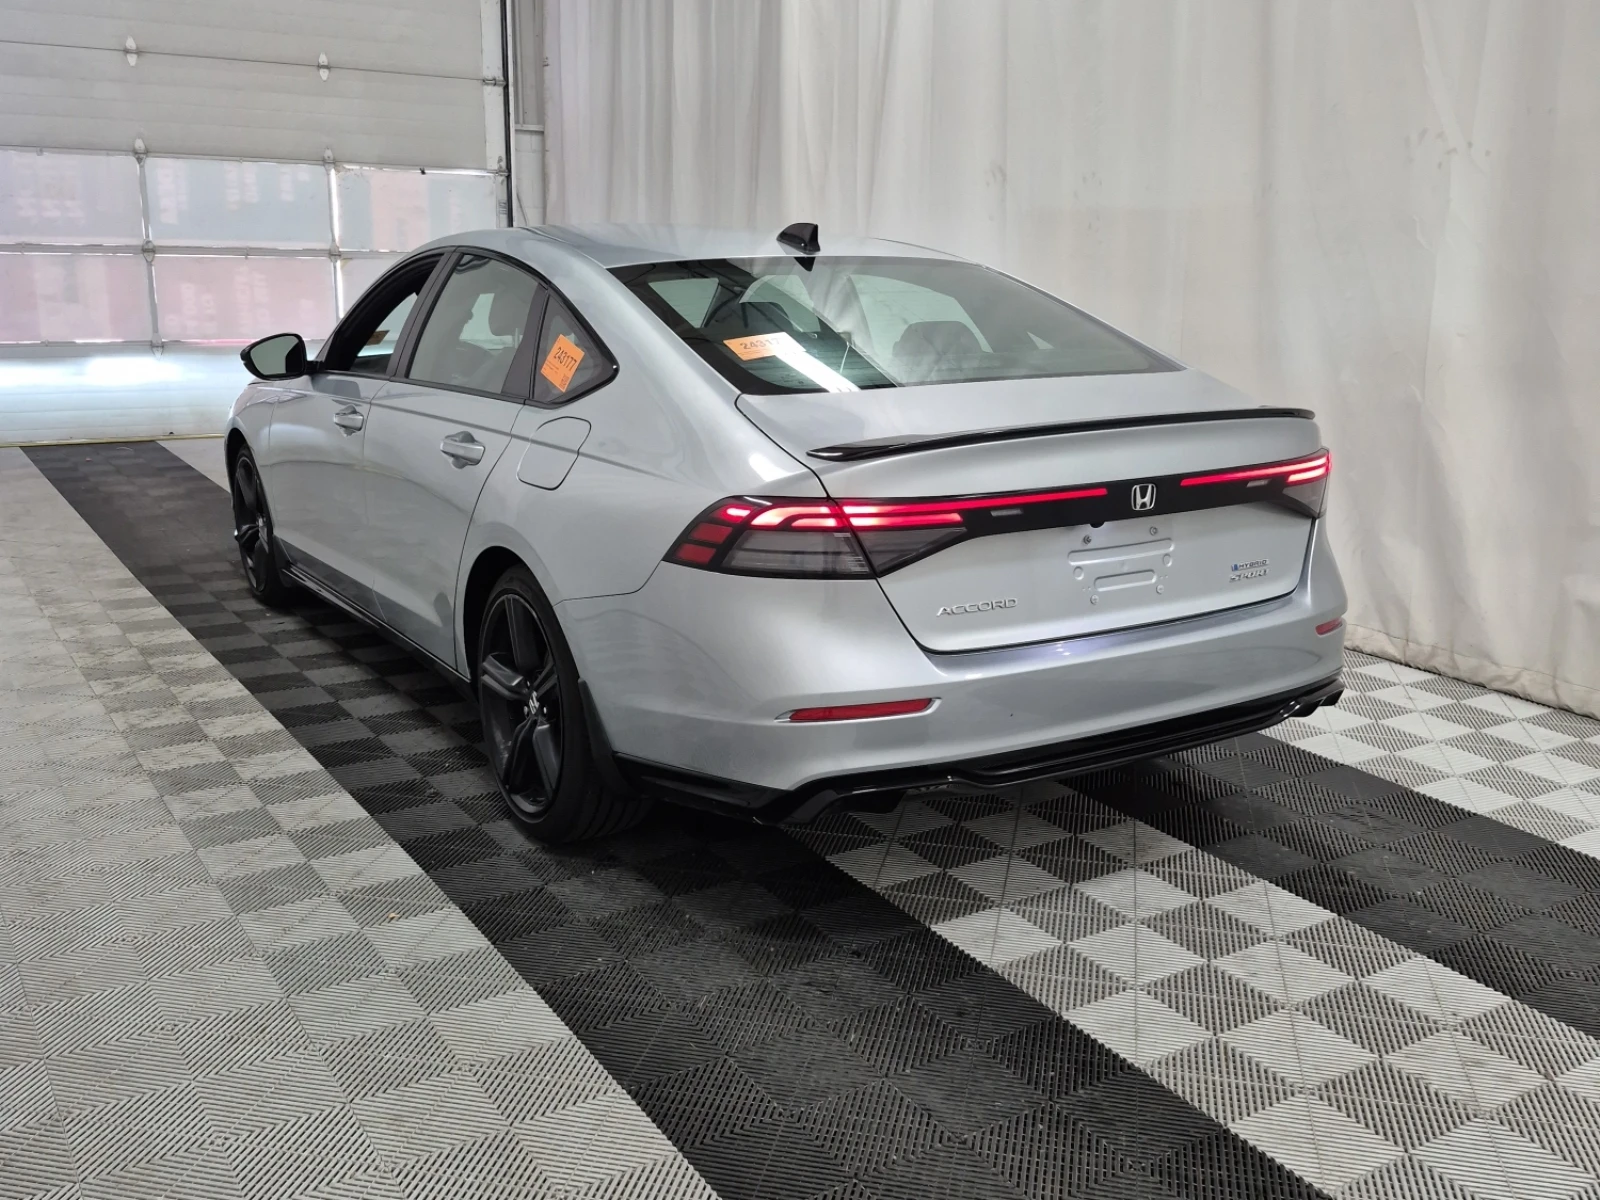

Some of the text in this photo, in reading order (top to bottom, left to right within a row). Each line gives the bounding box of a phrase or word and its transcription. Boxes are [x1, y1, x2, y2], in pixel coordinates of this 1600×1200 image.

[740, 337, 783, 350] 24317
[553, 346, 578, 372] 243177
[936, 598, 1018, 617] ACCORD
